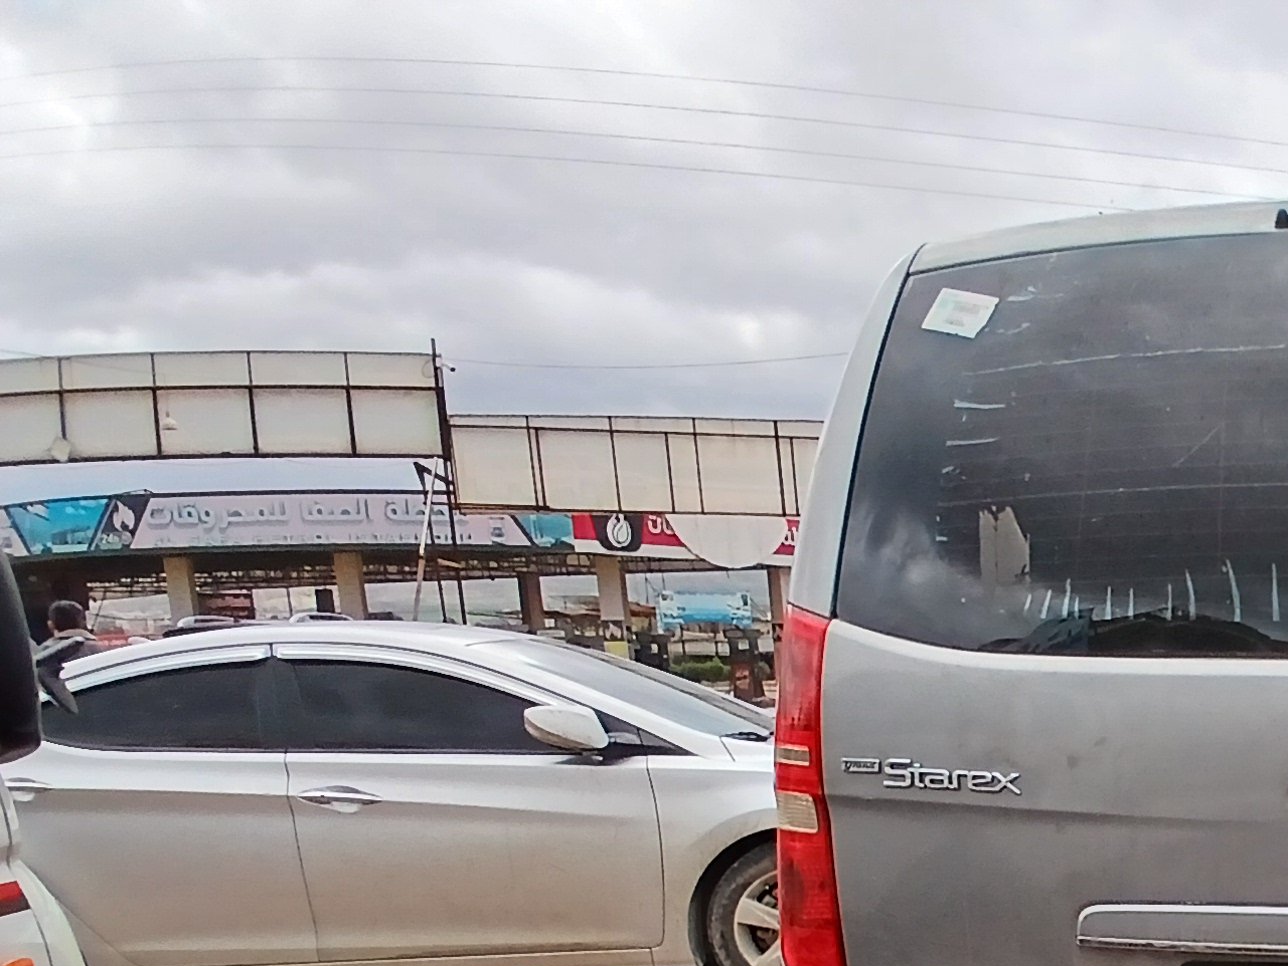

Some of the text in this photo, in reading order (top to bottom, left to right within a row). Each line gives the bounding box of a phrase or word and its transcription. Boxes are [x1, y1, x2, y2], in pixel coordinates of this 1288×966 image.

[147, 500, 290, 534] للمحروقات
[299, 498, 374, 526] الصفا
[883, 757, 1023, 796] Starex
